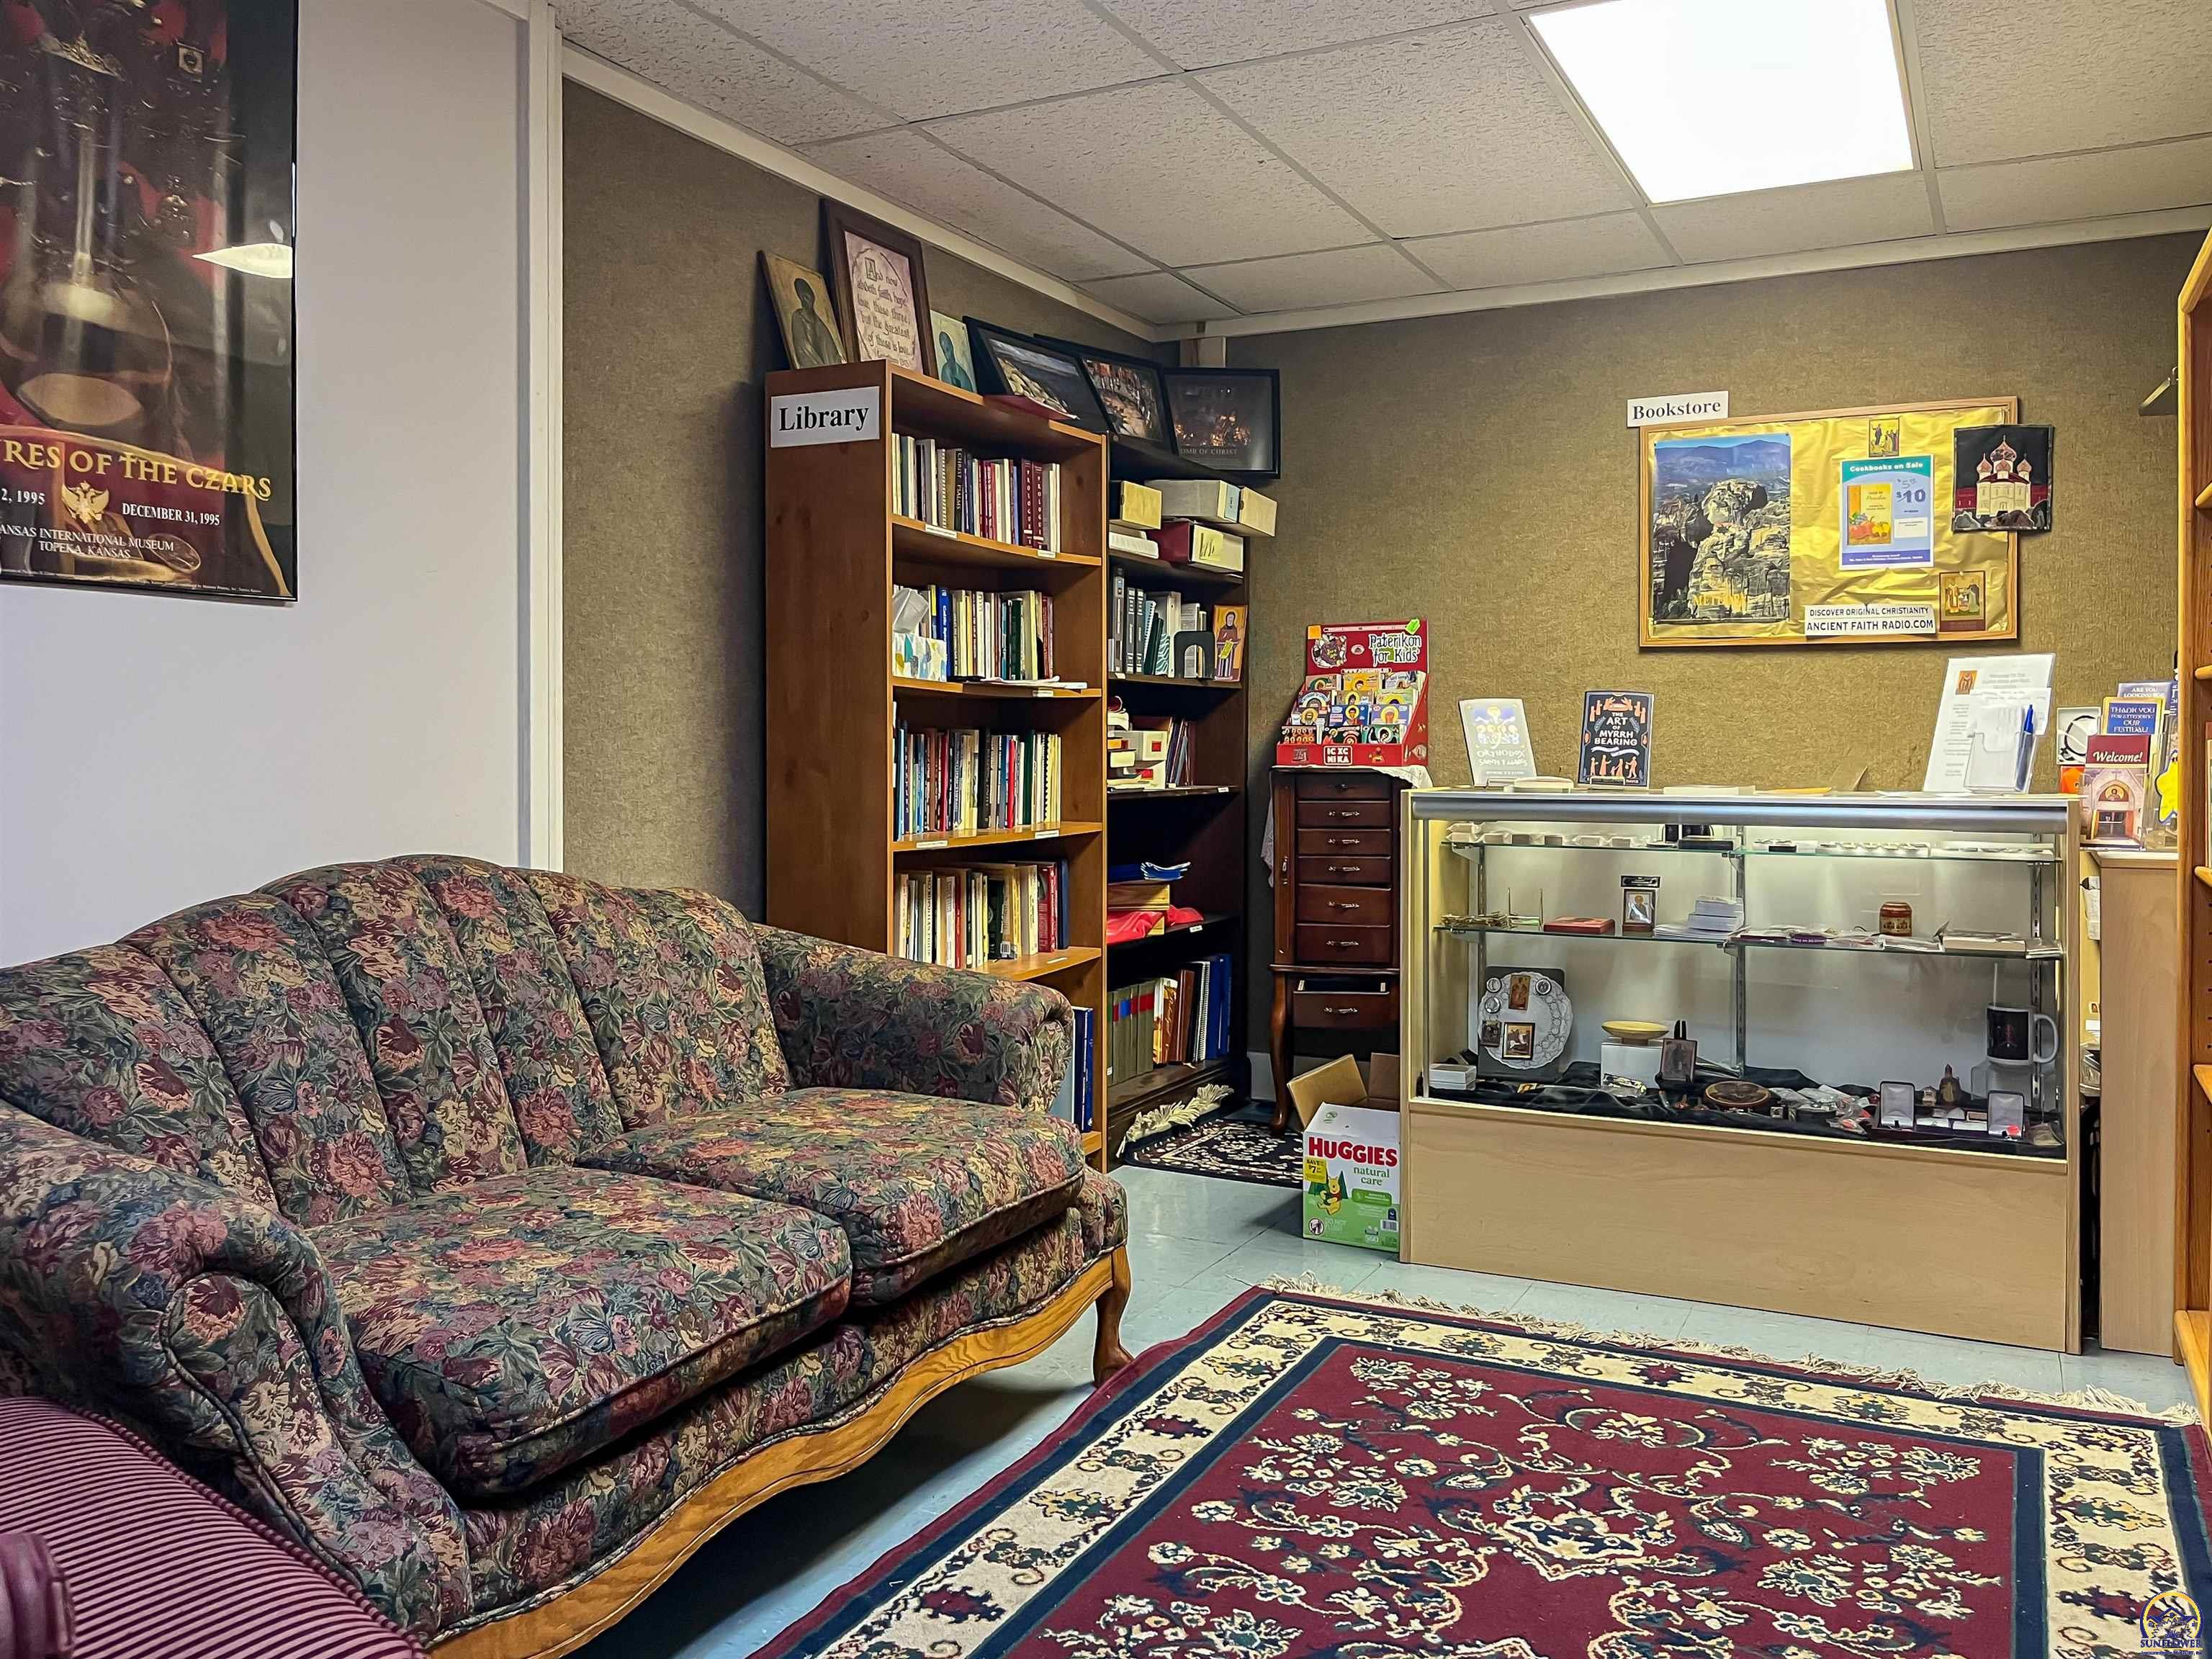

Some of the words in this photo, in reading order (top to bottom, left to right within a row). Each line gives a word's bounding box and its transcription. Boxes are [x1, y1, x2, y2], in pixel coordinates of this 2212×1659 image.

[1633, 402, 1721, 420] Bookstore
[779, 406, 869, 431] Library
[0, 439, 60, 469] RES
[70, 450, 112, 476] OF
[118, 451, 178, 485] THE
[186, 467, 271, 501] CZARS
[17, 490, 45, 505] 1995
[122, 503, 182, 522] DECEMBER
[184, 510, 198, 525] 31,
[200, 512, 220, 526] 1995
[0, 524, 37, 538] ANSAS
[40, 527, 127, 547] INTERNATIONAL
[128, 538, 174, 552] MUSEUM
[88, 545, 132, 559] KANSAS
[1846, 607, 1880, 616] ORIGINAL
[1807, 621, 1848, 631] ANCIENT
[1851, 621, 1879, 630] FAITH
[1881, 619, 1933, 629] RADIO.COM
[1370, 633, 1421, 648] Paterikon
[1374, 648, 1388, 665] for
[1394, 647, 1418, 662] Kids
[1606, 716, 1629, 726] ART
[1594, 737, 1638, 746] BEARING
[1599, 730, 1634, 739] MYRRH
[2092, 751, 2144, 762] Welcome!
[1308, 1136, 1398, 1167] HUGGIES
[1353, 1166, 1390, 1178] natural
[1361, 1176, 1383, 1186] care
